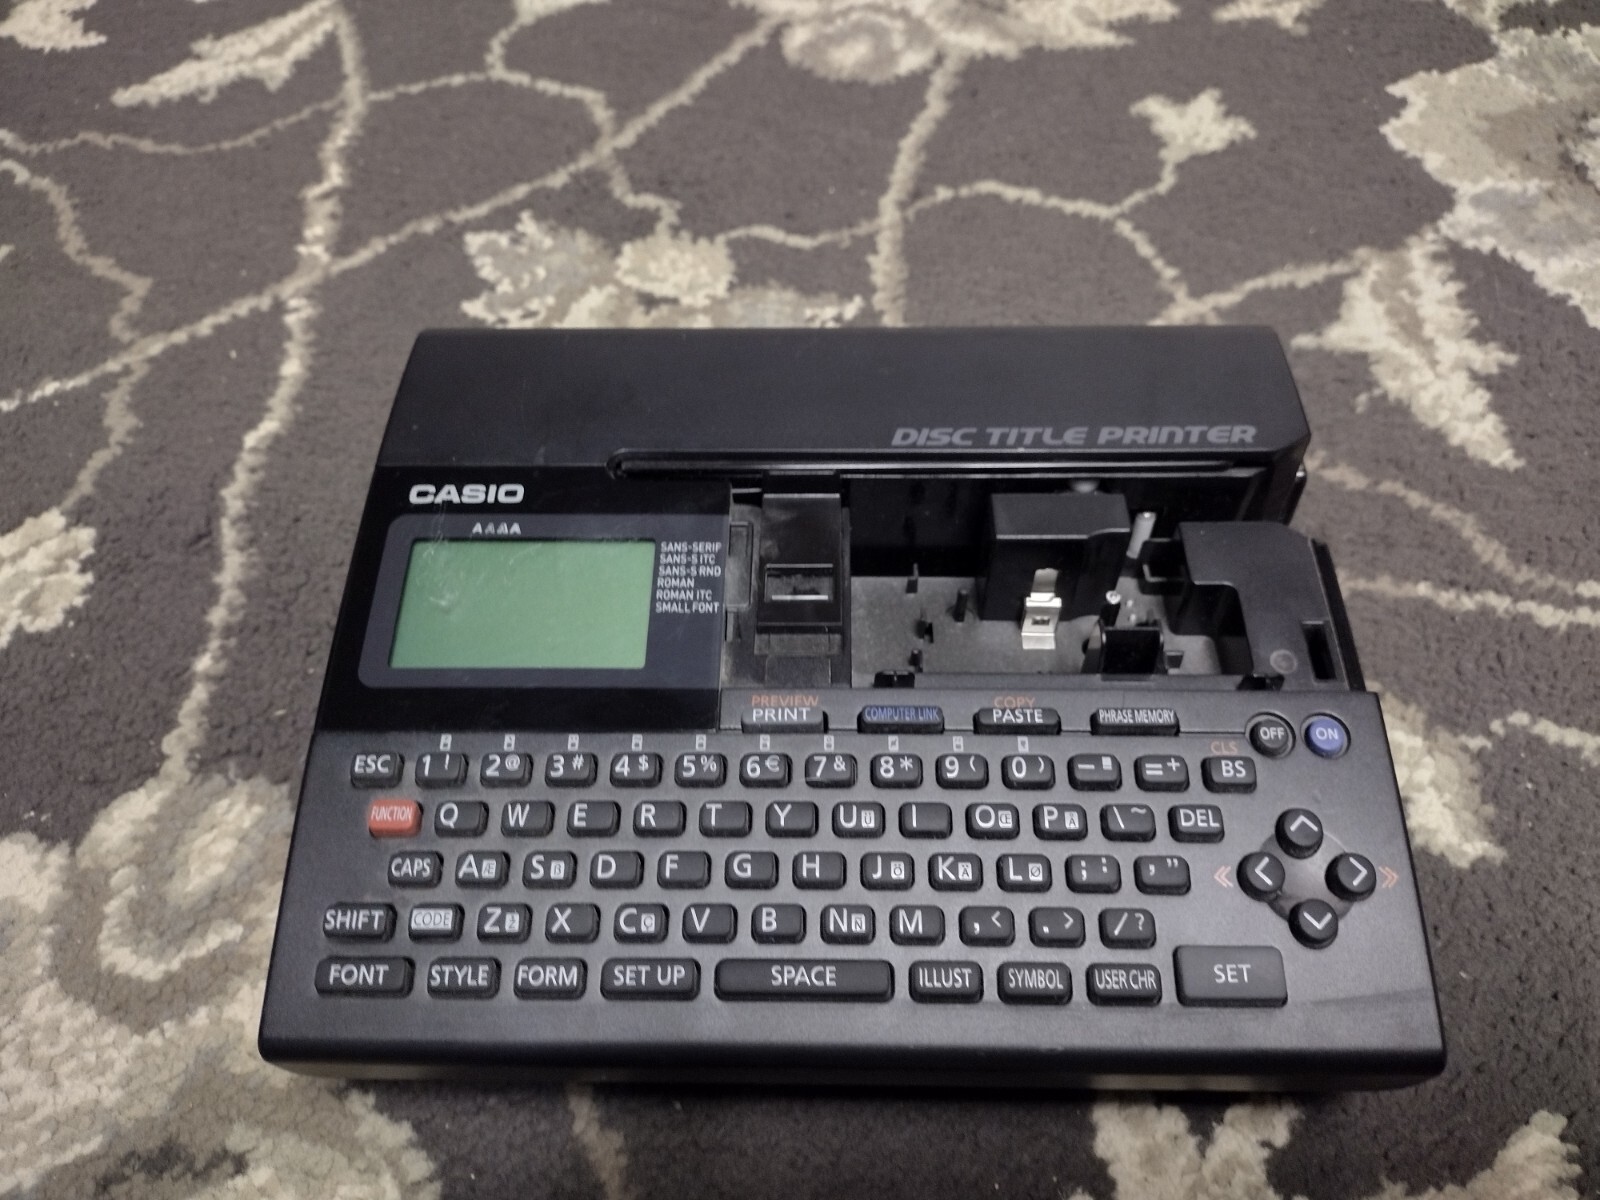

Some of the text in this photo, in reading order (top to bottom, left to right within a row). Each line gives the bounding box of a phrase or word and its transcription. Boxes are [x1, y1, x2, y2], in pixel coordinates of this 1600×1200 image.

[891, 424, 1257, 446] DISC TITLE PRINTER
[408, 483, 525, 505] CASIO
[699, 553, 716, 565] ITC
[699, 565, 722, 577] RND
[657, 577, 695, 589] ROMAN
[656, 589, 713, 601] ROMAN ITC
[655, 601, 720, 614] SMALL FONT
[751, 695, 819, 707] PREVIEW
[993, 696, 1036, 709] COPY
[752, 707, 811, 722] PRINT
[864, 706, 940, 721] COMPUTER LINK
[992, 709, 1043, 724] PASTE
[1098, 708, 1175, 725] PHRASE MEMORY
[1260, 727, 1285, 740] OFF
[1315, 728, 1339, 741] ON
[1210, 741, 1238, 754] CLS
[353, 754, 391, 774] ESC
[421, 754, 431, 776] 1
[485, 755, 501, 778] 2
[549, 755, 565, 777] 3
[614, 755, 631, 777] 4
[682, 754, 696, 778] 5
[746, 755, 761, 779] 6
[813, 755, 828, 778] 7
[879, 755, 895, 778] 8
[945, 756, 960, 779] 9
[1221, 760, 1246, 777] BS
[370, 805, 414, 821] FUNCTION
[439, 803, 459, 829] Q
[506, 803, 530, 828] W
[573, 803, 588, 828] E
[640, 803, 657, 828] R
[705, 803, 723, 827] T
[773, 803, 792, 828] Y
[838, 804, 858, 828] U
[975, 805, 995, 828] O
[1043, 806, 1058, 829] P
[1180, 809, 1220, 828] DEL
[390, 857, 431, 878] CAPS
[457, 855, 478, 879] A
[530, 854, 545, 880] S
[596, 854, 617, 879] D
[665, 855, 679, 879] F
[732, 853, 752, 878] G
[802, 854, 820, 879] H
[872, 855, 882, 880] J
[937, 856, 956, 881] K
[1008, 856, 1023, 881] L
[324, 909, 384, 930] SHIFT
[413, 911, 450, 927] CODE
[484, 907, 502, 933] Z
[551, 907, 572, 934] X
[619, 907, 637, 934] C
[690, 908, 711, 932] V
[761, 907, 777, 933] B
[829, 908, 849, 934] N
[899, 908, 923, 934] M
[328, 964, 389, 986] FONT
[430, 965, 489, 986] STYLE
[517, 965, 578, 986] FORM
[613, 964, 685, 986] SET UP
[770, 964, 837, 988] SPACE
[918, 967, 972, 989] ILLUST
[1008, 968, 1064, 990] SYMBOL
[1095, 969, 1157, 990] USER CHR
[1213, 963, 1252, 984] SET
